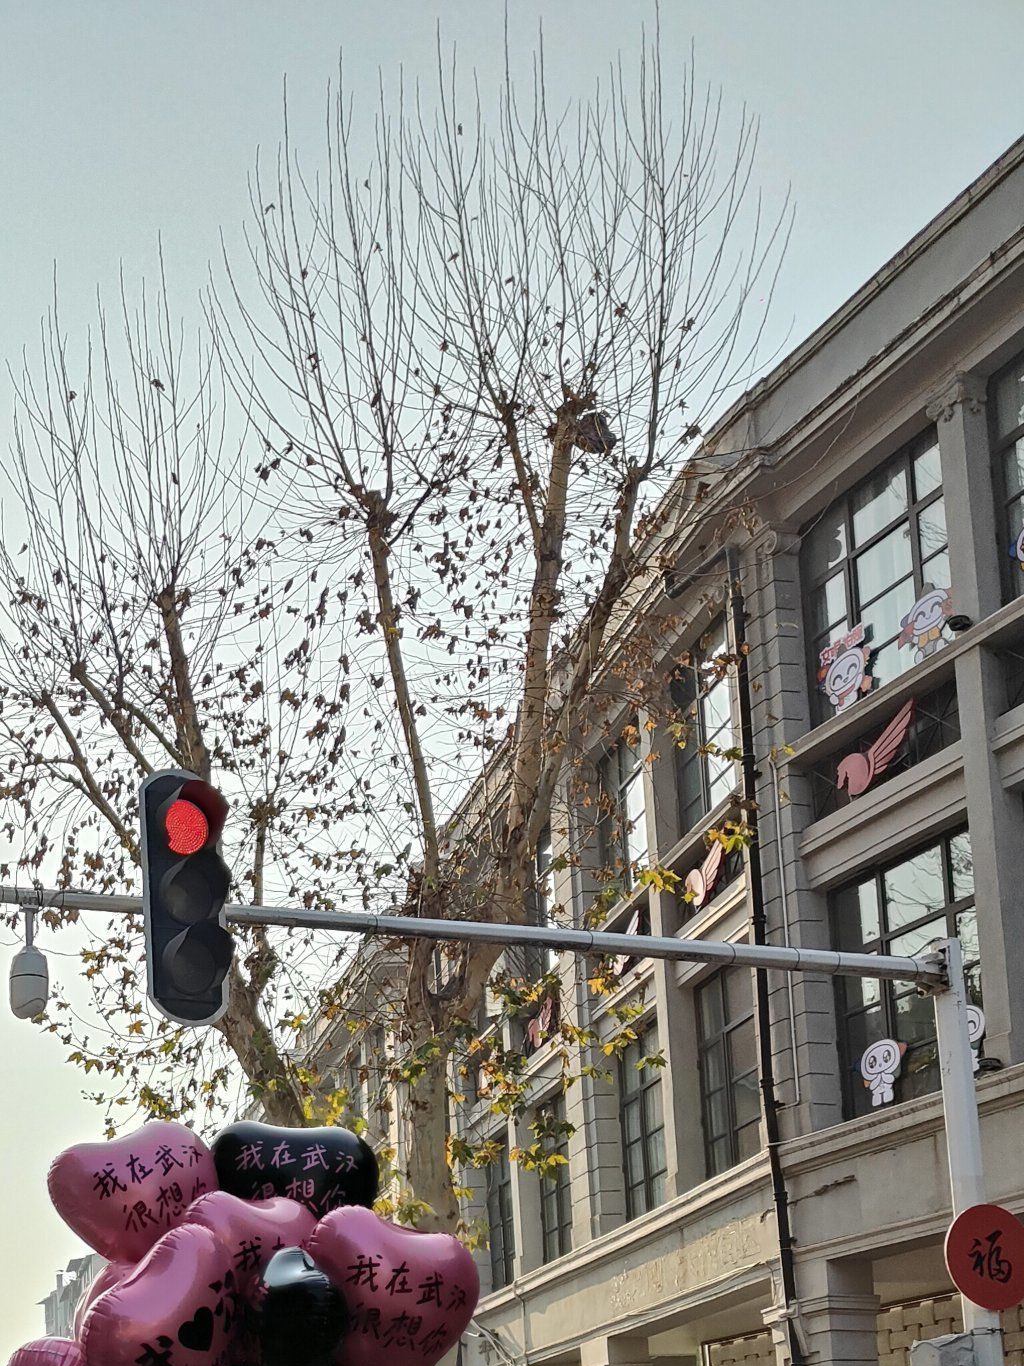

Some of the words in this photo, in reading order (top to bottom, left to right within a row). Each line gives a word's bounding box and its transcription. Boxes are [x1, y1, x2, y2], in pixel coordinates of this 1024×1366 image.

[92, 1143, 204, 1201] 我在武汉
[234, 1140, 359, 1172] 我在武汉
[345, 1254, 467, 1312] 我在武汉
[967, 1228, 1013, 1284] 福
[351, 1302, 448, 1356] 很想你
